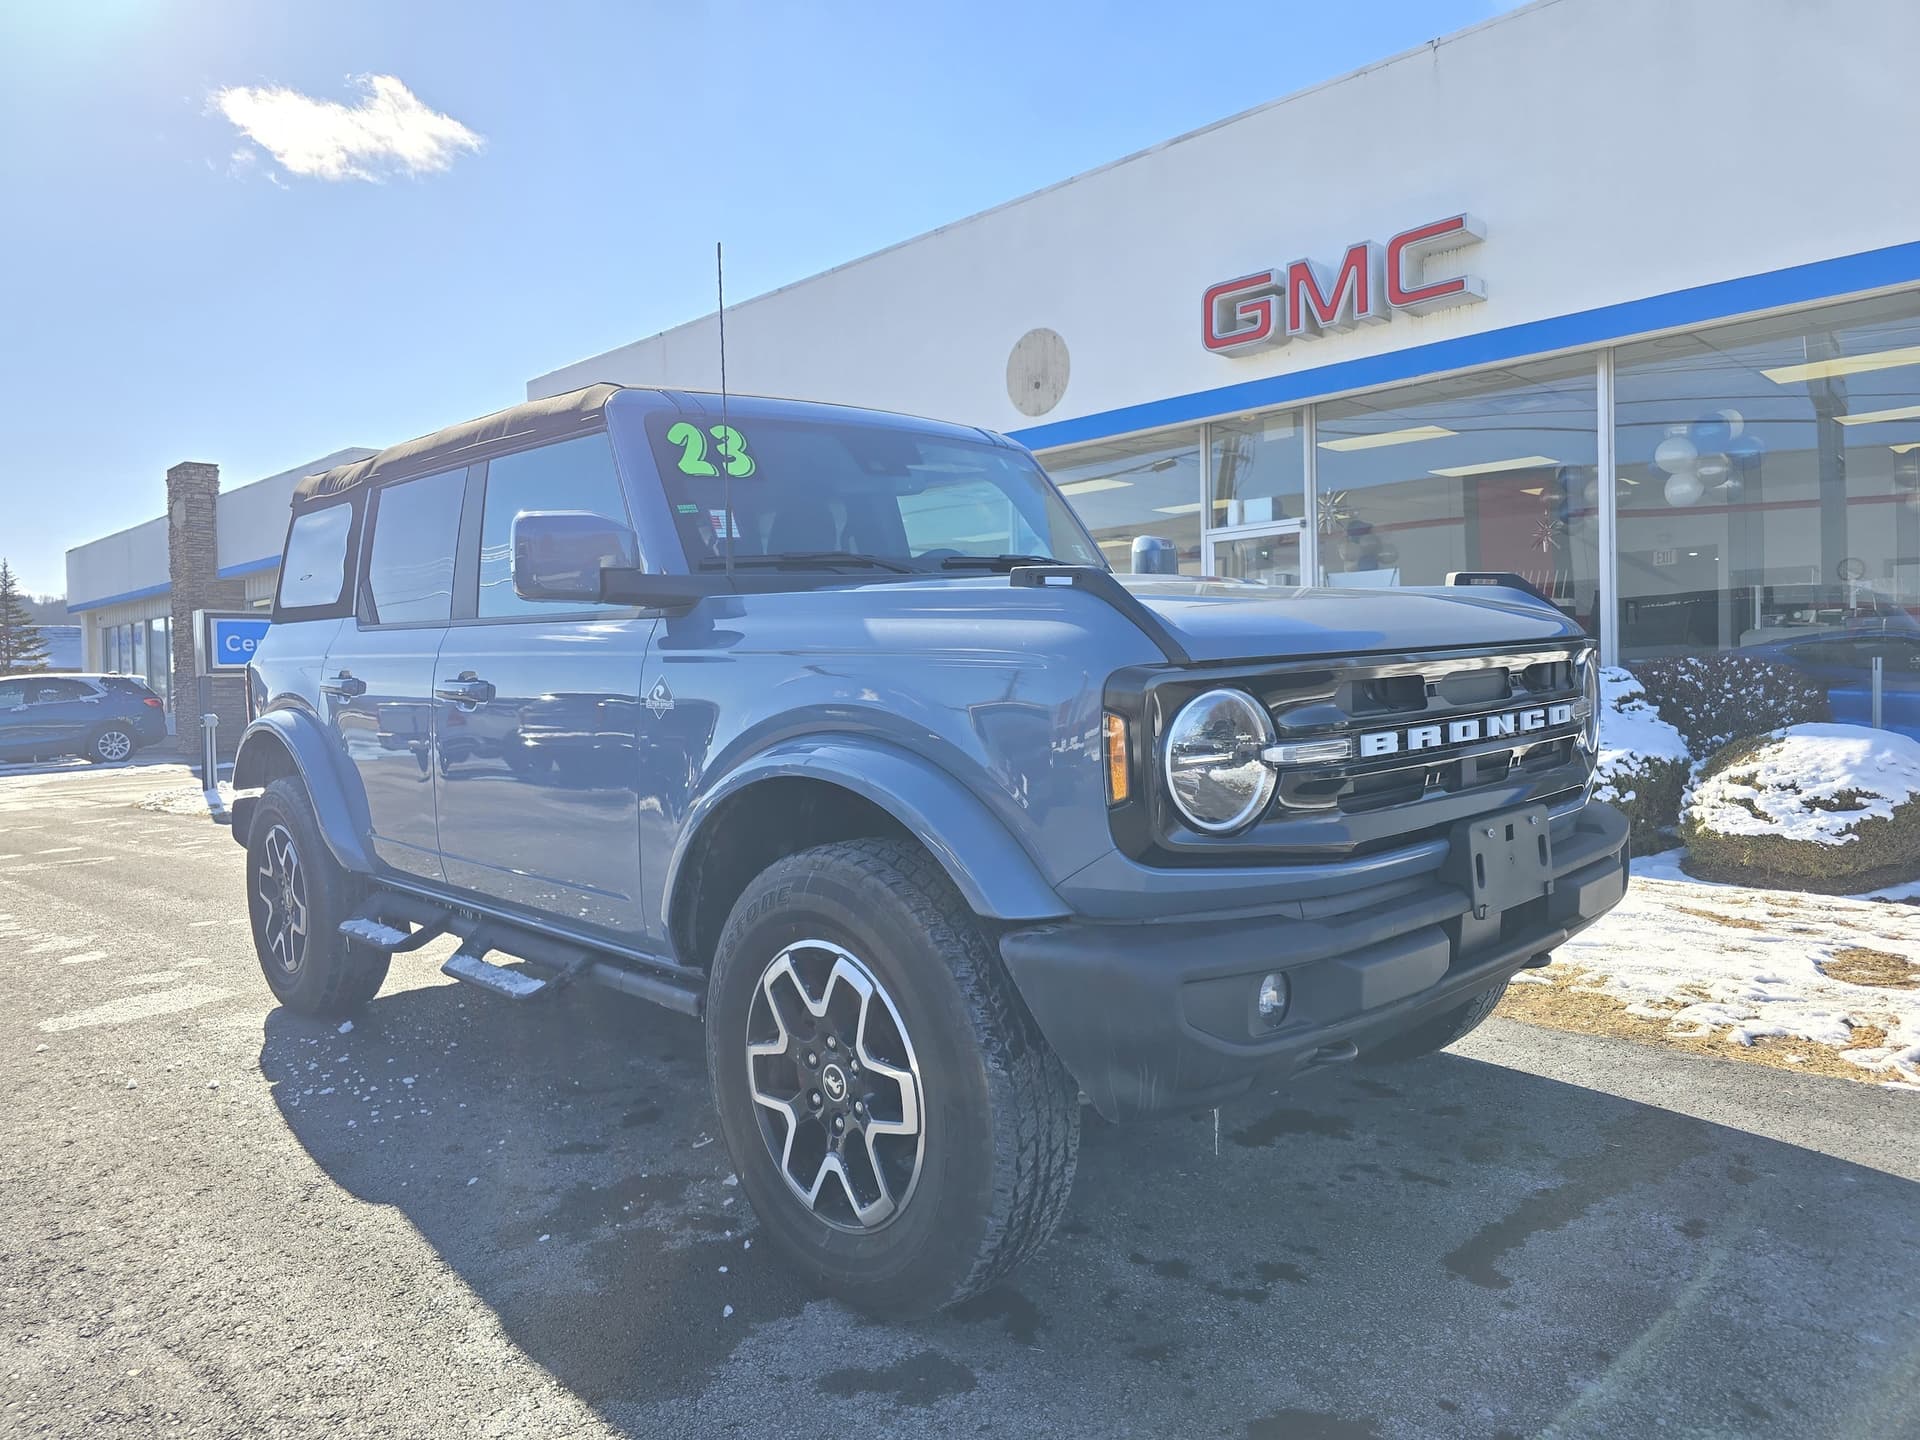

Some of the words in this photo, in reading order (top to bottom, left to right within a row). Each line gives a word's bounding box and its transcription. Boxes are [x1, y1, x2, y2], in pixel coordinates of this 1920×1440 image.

[1201, 212, 1487, 357] GMC
[666, 421, 756, 478] 23
[1360, 704, 1571, 758] BRONCO
